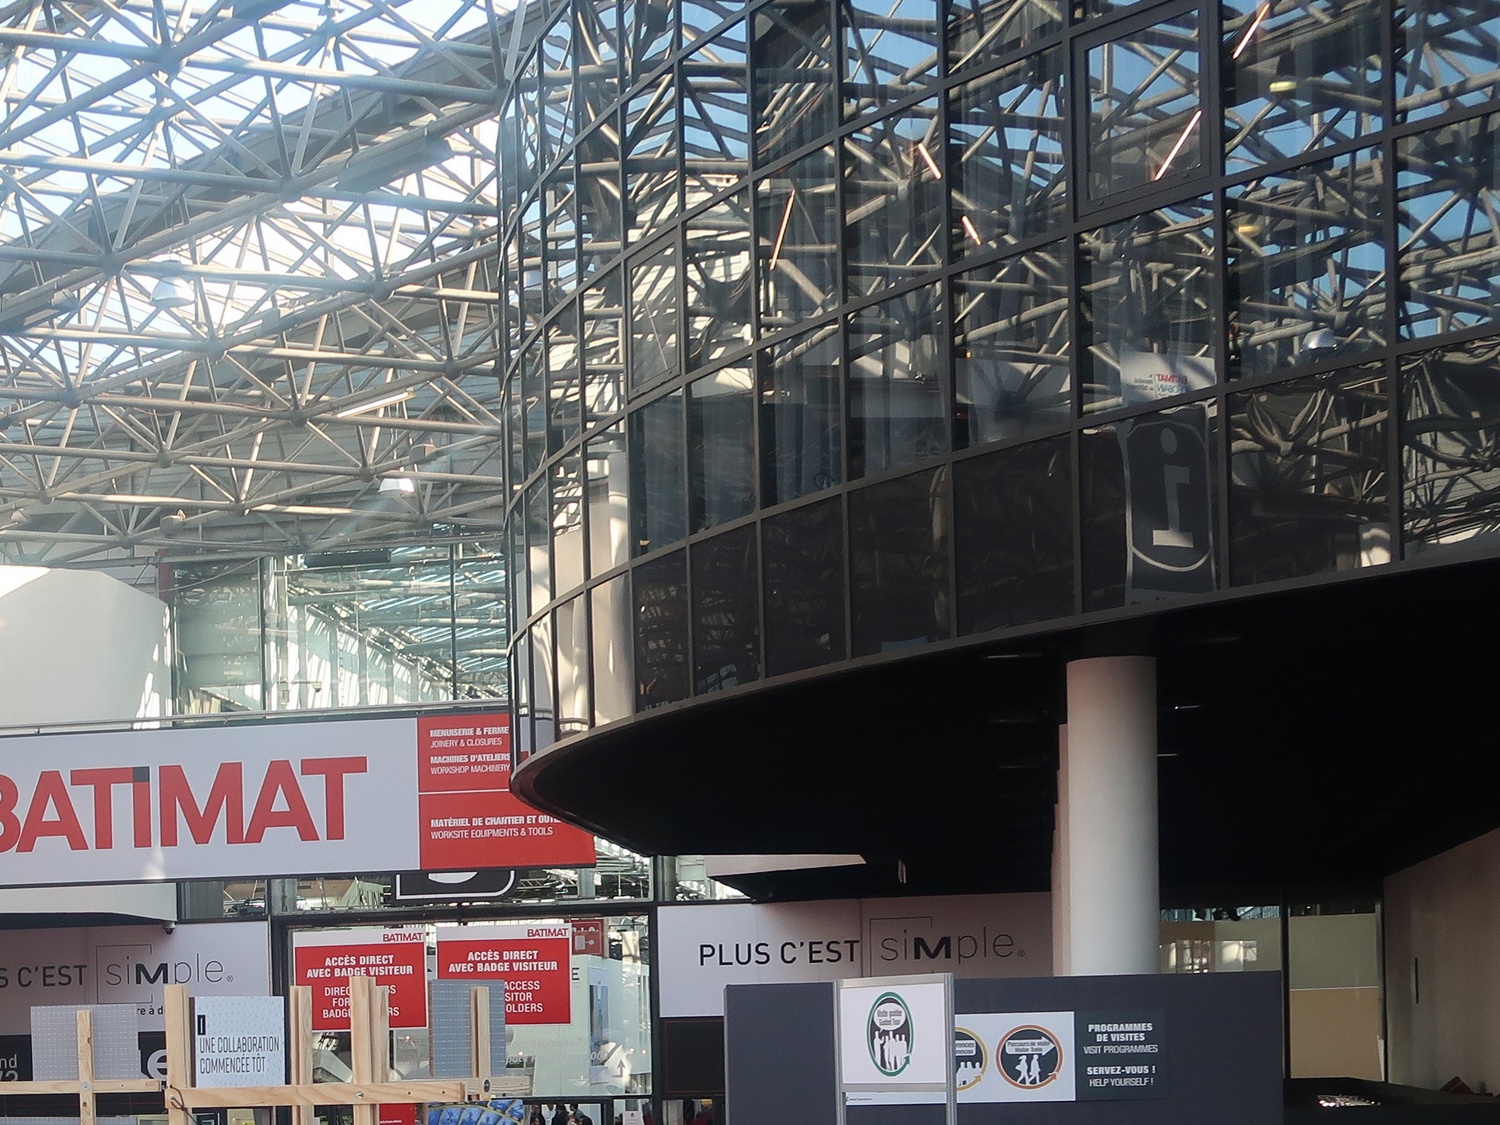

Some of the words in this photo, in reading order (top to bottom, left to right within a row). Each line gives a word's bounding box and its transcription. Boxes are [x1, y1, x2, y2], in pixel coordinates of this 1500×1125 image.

[430, 728, 474, 738] MENUISERIE
[476, 727, 482, 736] &
[483, 726, 509, 735] FERME
[430, 739, 458, 748] JOINERY
[459, 738, 465, 747] &
[466, 737, 502, 747] CLOSURES
[430, 754, 468, 764] MACHINES
[430, 765, 470, 775] WORKSHOP
[471, 764, 510, 773] MACHINERY
[430, 816, 471, 828] MATÉRIEL
[472, 817, 483, 826] DE
[485, 816, 524, 826] CHANTIER
[526, 815, 536, 824] ET
[431, 830, 470, 840] WORKSITE
[471, 827, 518, 838] EQUIPMENTS
[520, 827, 526, 836] &
[528, 826, 553, 836] TOOLS
[382, 932, 423, 942] BATIMAT
[527, 928, 569, 938] BATIMAT
[468, 949, 500, 961] ACCÈS
[503, 950, 538, 960] DIRECT
[700, 943, 770, 966] PLUS
[780, 940, 859, 964] C'EST
[325, 954, 357, 966] ACCÈS
[359, 954, 394, 965] DIRECT
[307, 968, 332, 978] AVEC
[334, 967, 367, 977] BADGE
[369, 965, 413, 976] VISITEUR
[448, 963, 475, 973] AVEC
[477, 962, 510, 972] BADGE
[512, 961, 558, 971] VISITEUR
[17, 965, 87, 987] C'EST
[504, 980, 540, 991] ACCESS
[324, 986, 351, 997] DIREC
[504, 992, 532, 1002] SITOR
[332, 997, 350, 1007] FOR
[505, 1003, 543, 1013] OLDERS
[1088, 1023, 1153, 1032] PROGRAMMES
[1096, 1033, 1108, 1042] DE
[1110, 1033, 1145, 1042] VISITES
[200, 1037, 215, 1053] UNE
[217, 1035, 280, 1053] COLLABORATION
[1083, 1045, 1102, 1054] VISIT
[1103, 1044, 1158, 1053] PROGRAMMES
[200, 1056, 250, 1074] COMMENCÉE
[252, 1055, 266, 1073] TÔT
[1087, 1066, 1149, 1075] SERVEZ-VOUS
[1089, 1078, 1109, 1087] HELP
[1110, 1077, 1149, 1086] YOURSELF
